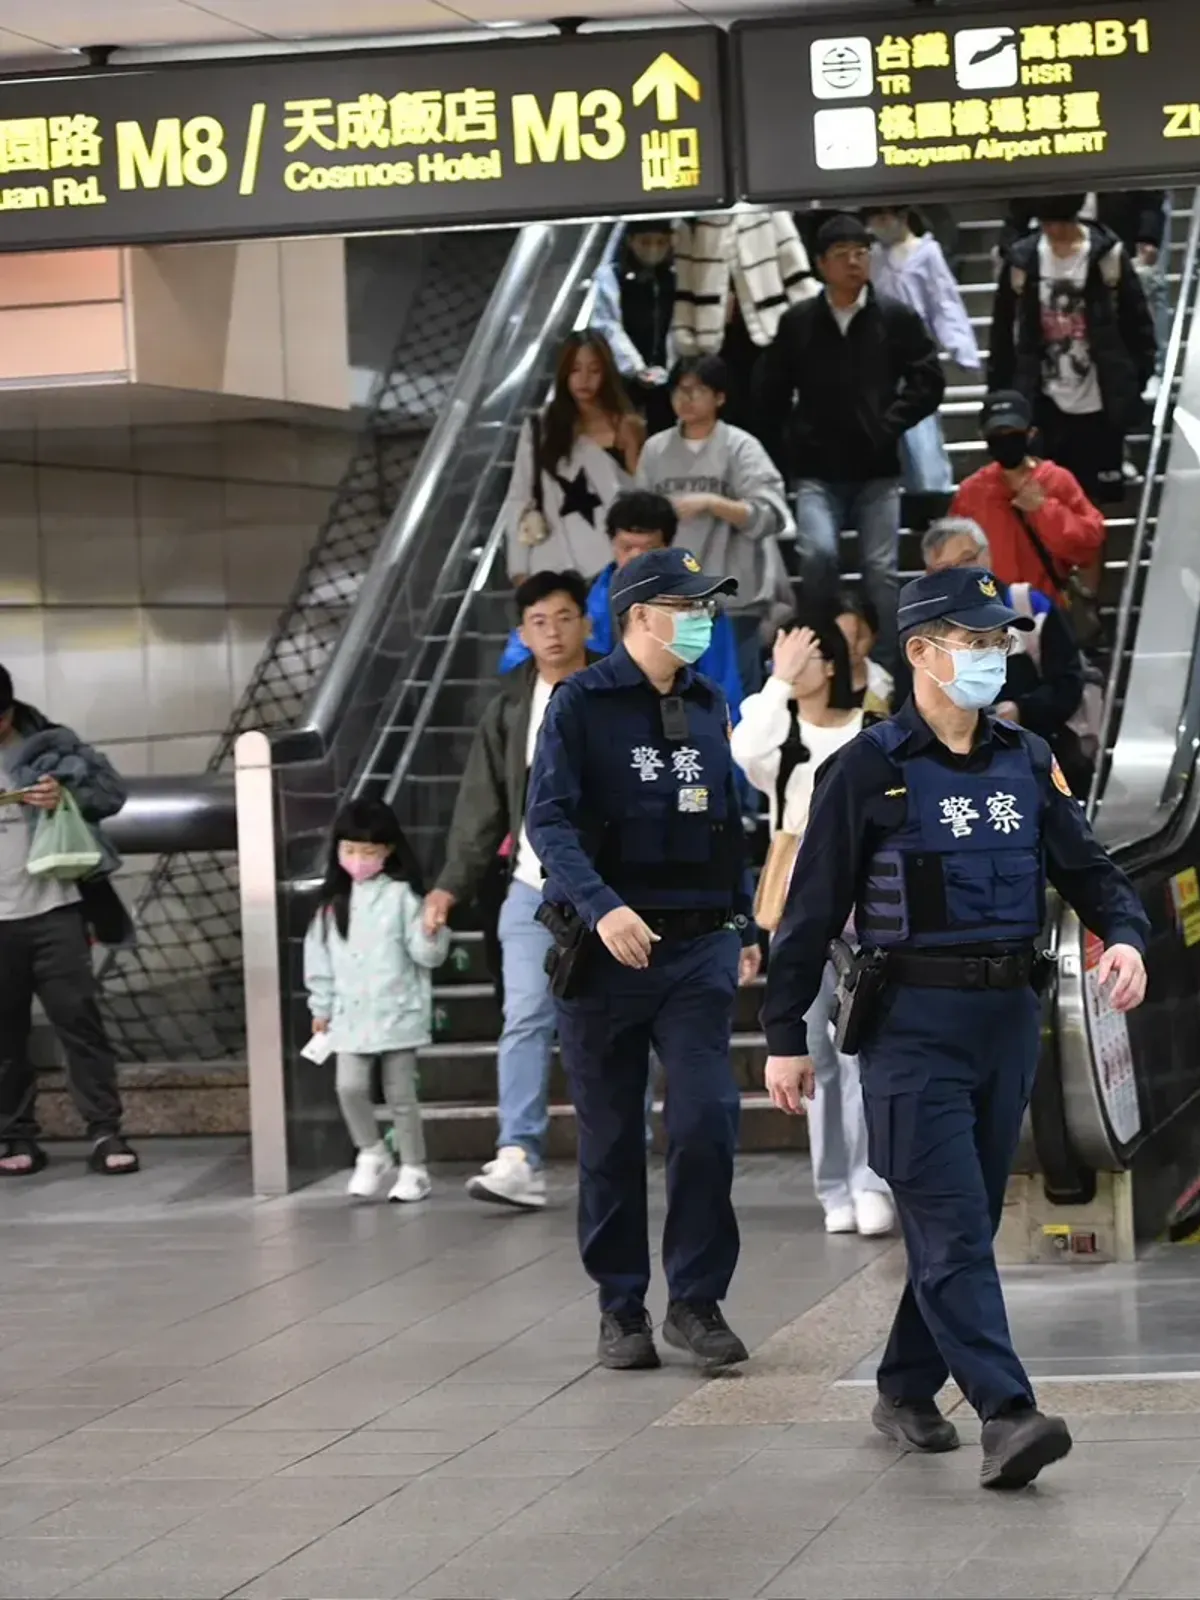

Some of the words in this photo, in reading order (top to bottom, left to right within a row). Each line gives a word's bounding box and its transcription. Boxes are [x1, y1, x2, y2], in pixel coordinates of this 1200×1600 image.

[876, 74, 911, 95] TR
[1021, 62, 1073, 84] HSR
[284, 88, 498, 153] 天成飯店
[511, 89, 626, 165] M3
[878, 90, 1101, 140] 桃園機場捷運
[116, 115, 228, 190] M8
[239, 103, 266, 195] /
[283, 161, 415, 191] Cosmos
[418, 149, 502, 183] Hotel
[641, 128, 699, 191] 出口
[879, 143, 972, 167] Taoyuan
[974, 137, 1052, 162] Airport
[1054, 130, 1108, 155] MRT
[53, 175, 107, 206] Rd.
[629, 745, 704, 783] 警察
[938, 790, 1024, 839] 警察
